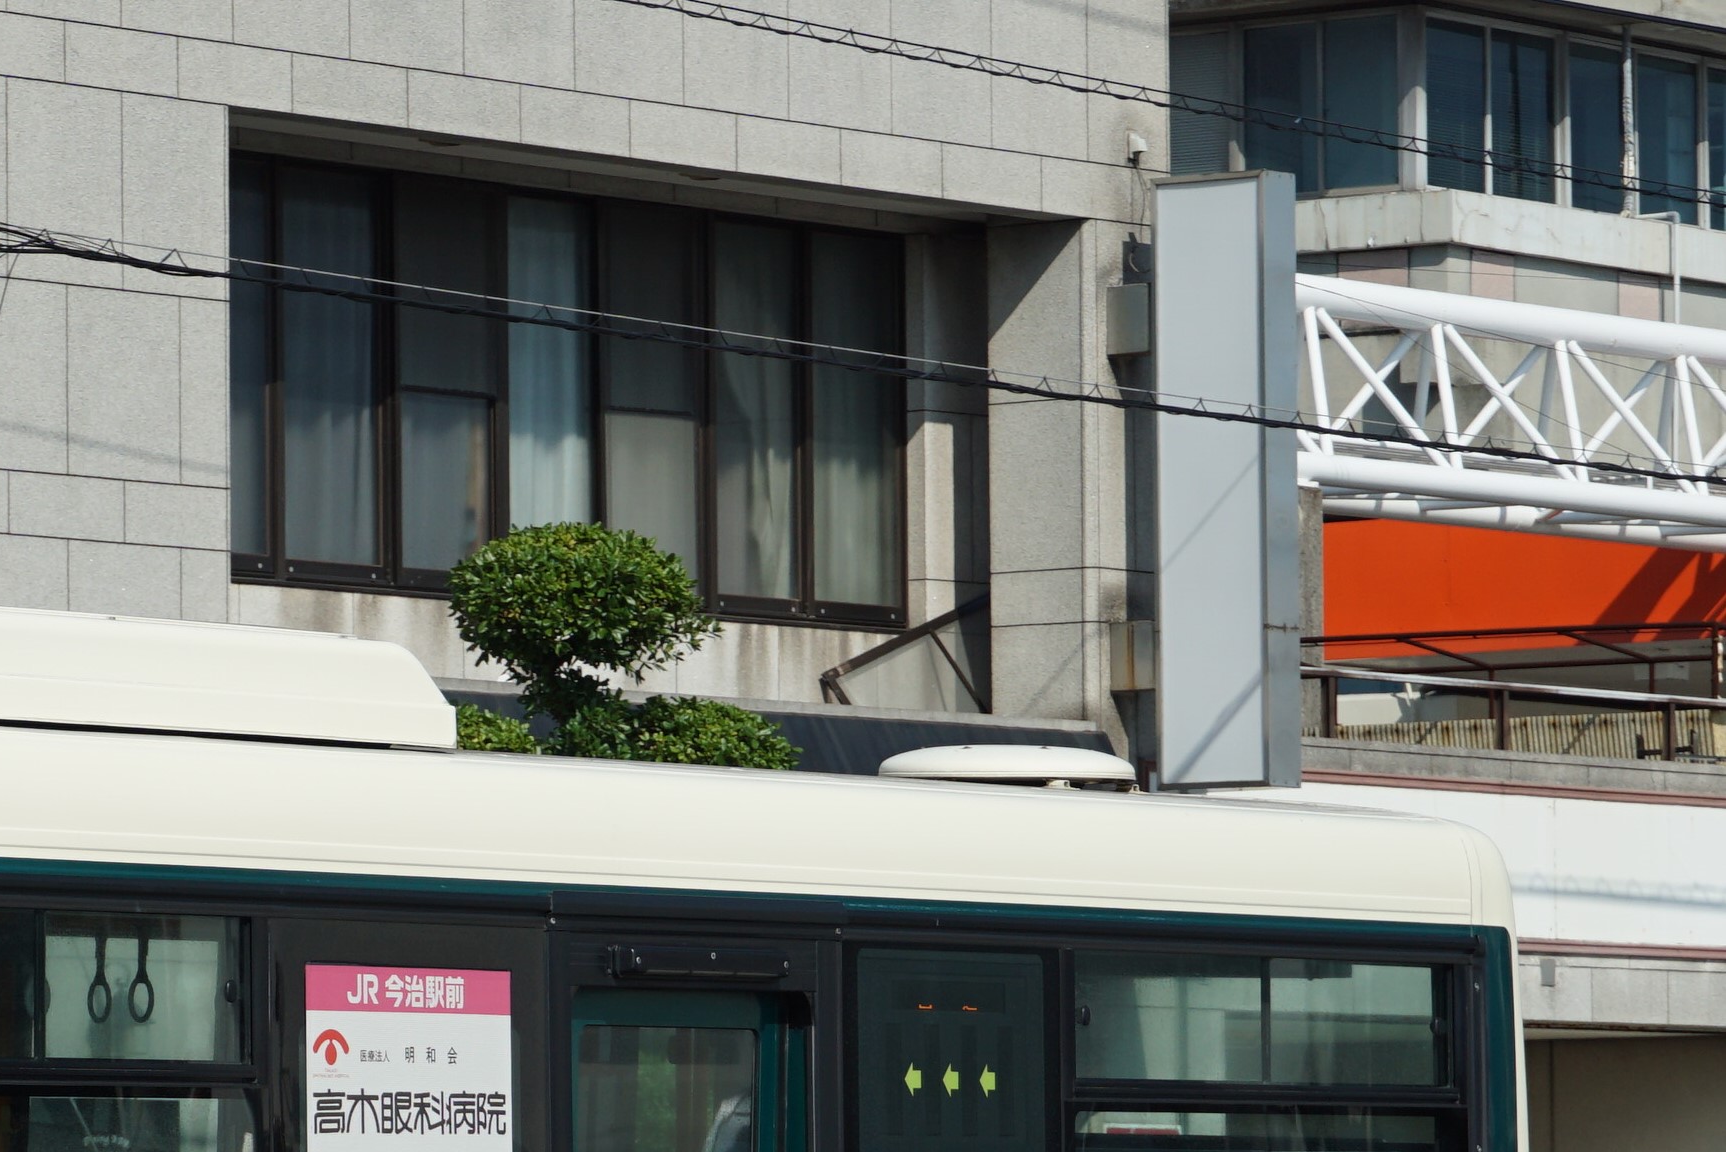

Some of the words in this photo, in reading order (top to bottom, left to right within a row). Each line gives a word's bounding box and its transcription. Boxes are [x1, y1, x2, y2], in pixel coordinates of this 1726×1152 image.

[347, 973, 379, 1004] JR
[384, 974, 465, 1009] 今治駅前
[360, 1049, 390, 1063] 医療法人
[313, 1088, 506, 1135] 高木眼科病院
